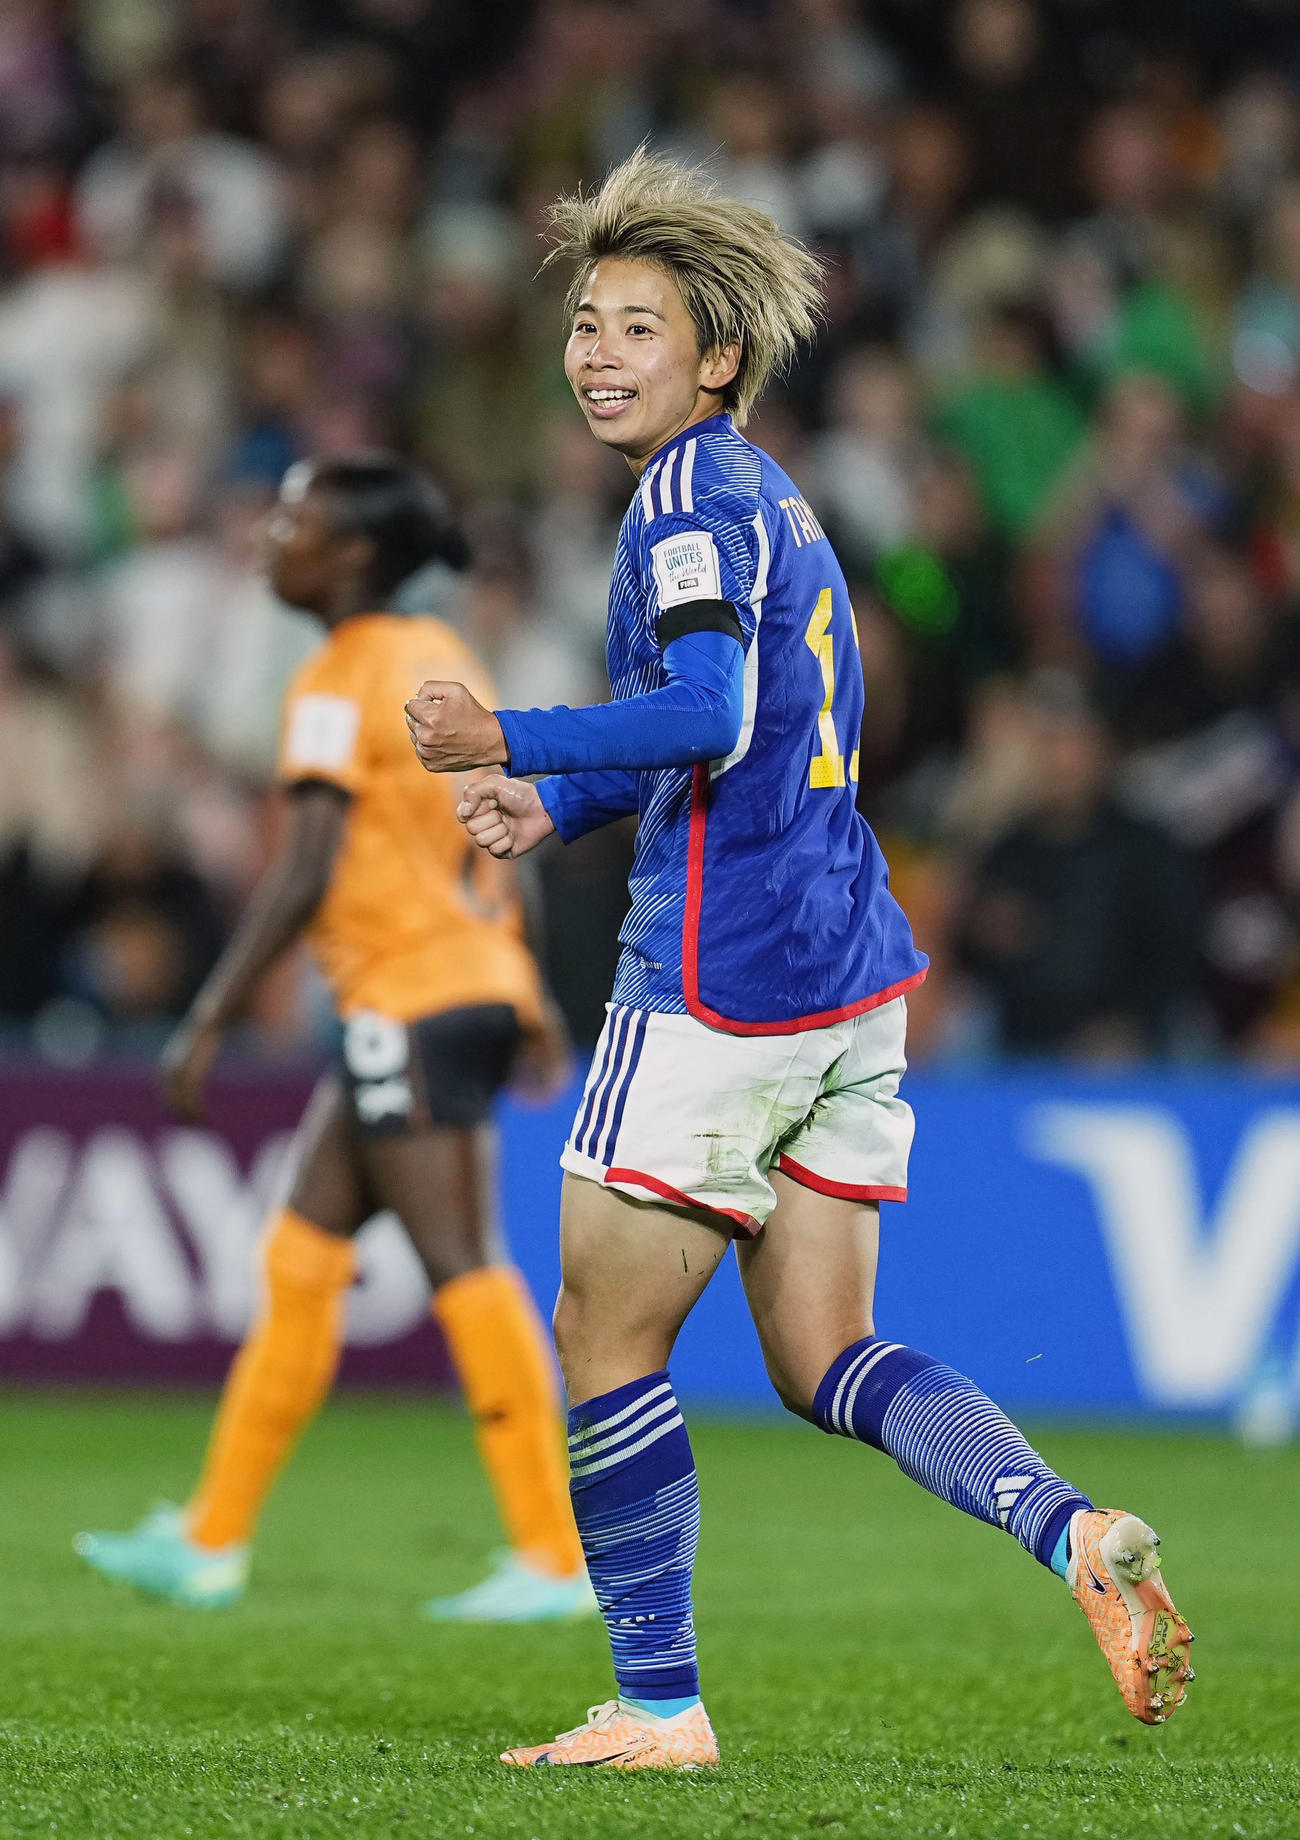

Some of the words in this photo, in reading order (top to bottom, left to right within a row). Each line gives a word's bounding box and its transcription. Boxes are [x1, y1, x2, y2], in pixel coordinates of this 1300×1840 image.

[663, 542, 702, 558] FOOTBALL
[665, 551, 704, 571] UNITES
[682, 562, 708, 577] World
[679, 578, 698, 589] FIFA
[804, 583, 859, 789] 1
